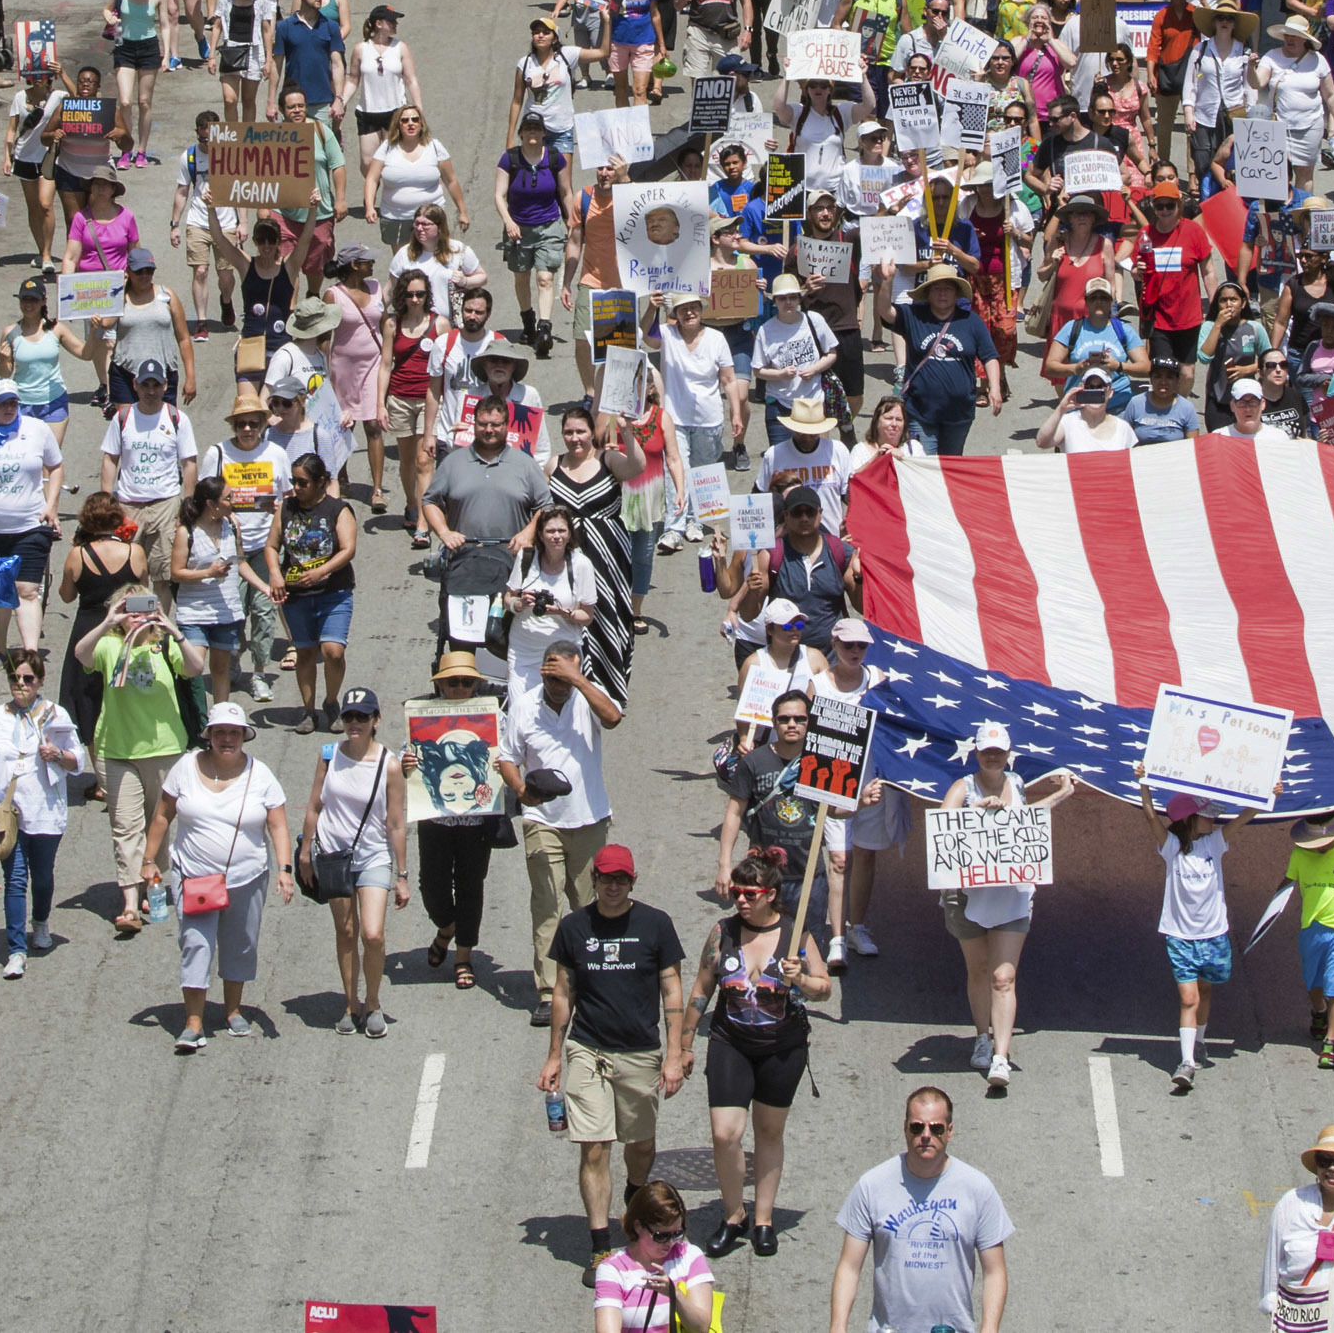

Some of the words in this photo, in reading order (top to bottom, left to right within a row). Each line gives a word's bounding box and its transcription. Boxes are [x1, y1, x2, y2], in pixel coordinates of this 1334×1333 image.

[806, 43, 847, 58] CHILD
[817, 58, 855, 77] ABUSE
[893, 86, 917, 97] NEVER
[64, 100, 101, 111] FAMILIES
[894, 96, 917, 106] AGAIN
[63, 111, 92, 122] BELONG
[62, 123, 102, 134] TOGETHER
[209, 124, 237, 143] Make
[243, 125, 303, 144] America
[1243, 121, 1275, 142] Yes!
[210, 146, 310, 178] HUMANE
[1260, 147, 1284, 165] DO
[230, 180, 279, 204] AGAIN
[617, 188, 666, 245] KIDNAPPER
[630, 259, 674, 278] Reunite
[648, 275, 692, 291] Families
[347, 691, 366, 704] 17
[930, 809, 987, 831] THEY
[994, 808, 1046, 825] CAME
[933, 832, 972, 852] FOR
[972, 828, 1009, 848] THE
[1013, 826, 1049, 843] KIDS
[934, 850, 972, 872] AND
[959, 866, 1006, 888] HELL
[1009, 862, 1042, 884] NO!
[602, 962, 636, 970] Survived
[883, 1198, 957, 1238] Waukegan
[924, 1251, 938, 1259] the
[309, 1306, 338, 1319] ACLU
